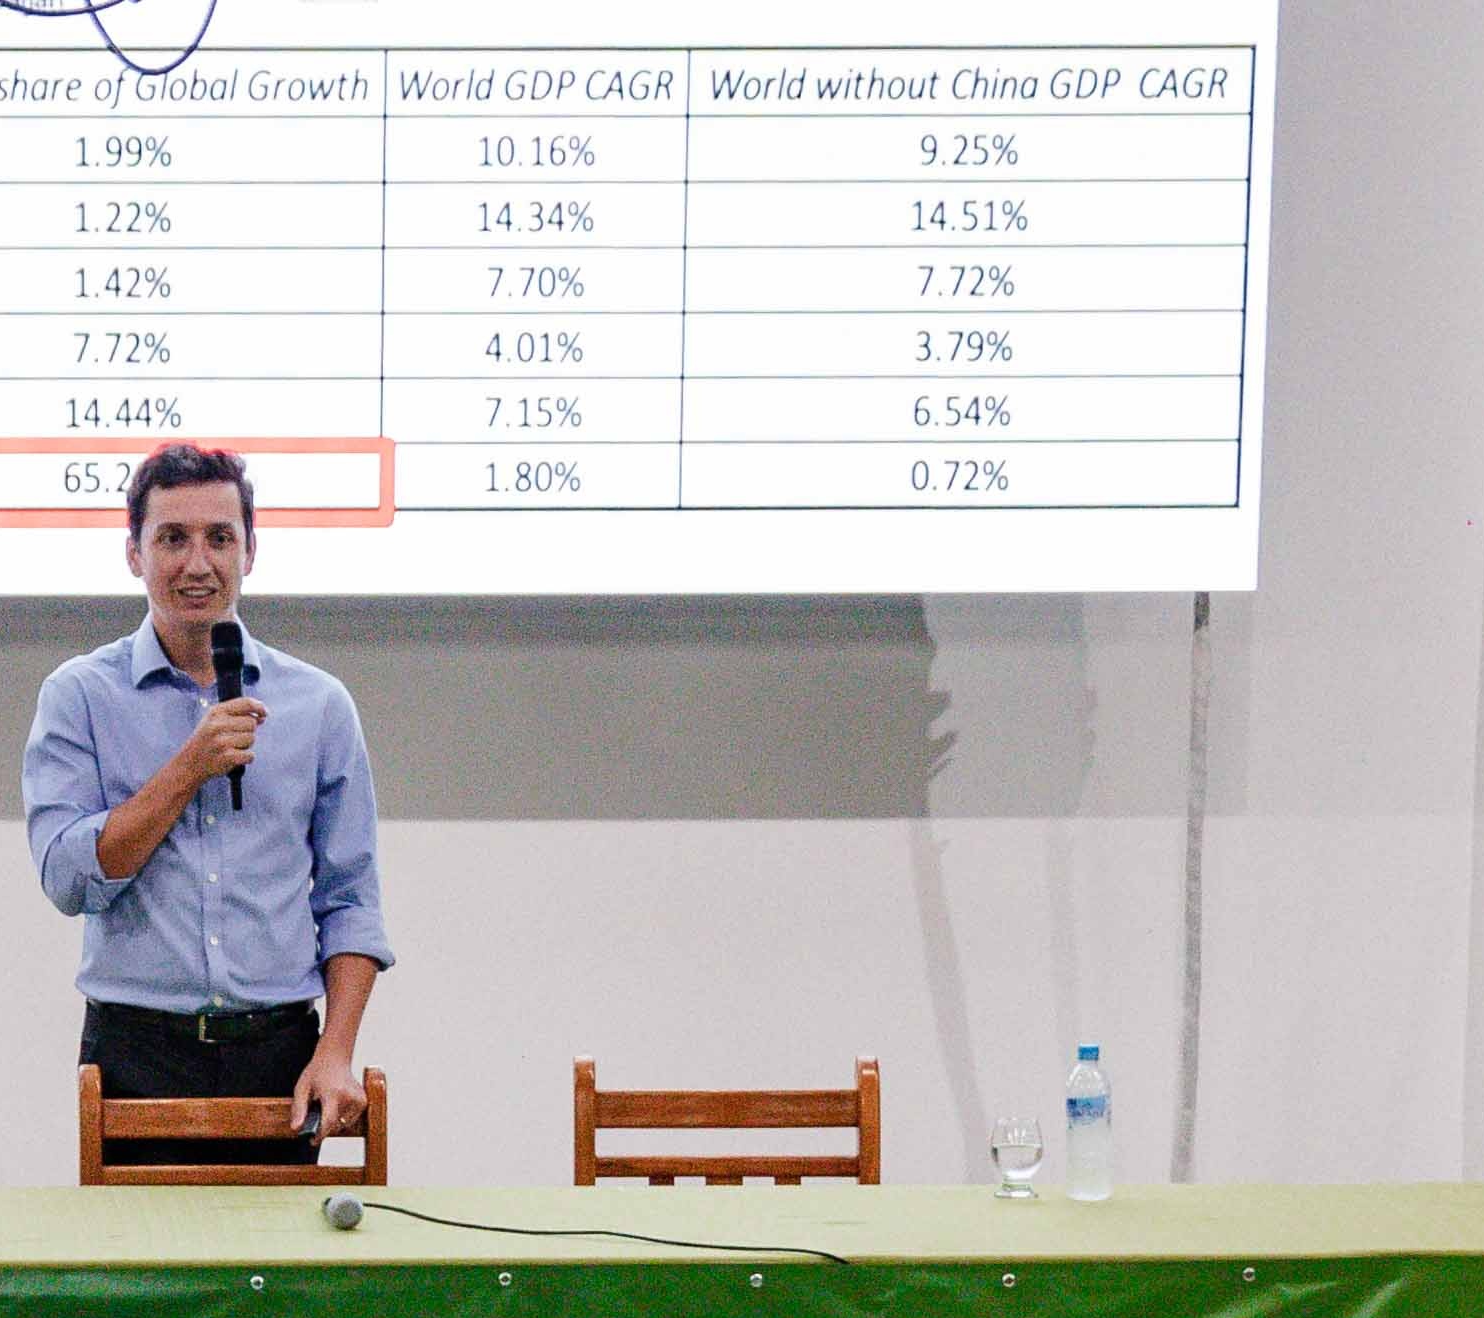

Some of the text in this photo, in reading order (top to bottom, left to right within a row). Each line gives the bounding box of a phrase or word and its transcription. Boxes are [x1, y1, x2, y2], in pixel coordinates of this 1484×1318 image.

[94, 69, 132, 109] of
[135, 69, 238, 104] Global
[245, 69, 370, 101] Growth
[398, 69, 675, 101] World GDP CAGR
[709, 67, 1230, 101] World without China GDP CAGR
[76, 136, 173, 168] 1.99%
[479, 136, 596, 167] 10.16%
[918, 134, 1020, 166] 9.25%
[75, 201, 173, 233] 1.22%
[478, 201, 595, 233] 14.34%
[911, 200, 1029, 232] 14.51%
[75, 267, 173, 298] 1.42%
[487, 266, 585, 297] 7.70%
[917, 265, 1016, 297] 7.72%
[72, 332, 172, 364] 7.72%
[483, 332, 584, 363] 4.01%
[914, 330, 1014, 362] 3.79%
[65, 397, 183, 429] 14.44%
[486, 397, 583, 428] 7.15%
[911, 395, 1012, 427] 6.54%
[485, 461, 582, 493] 1.80%
[909, 460, 1010, 492] 0.72%
